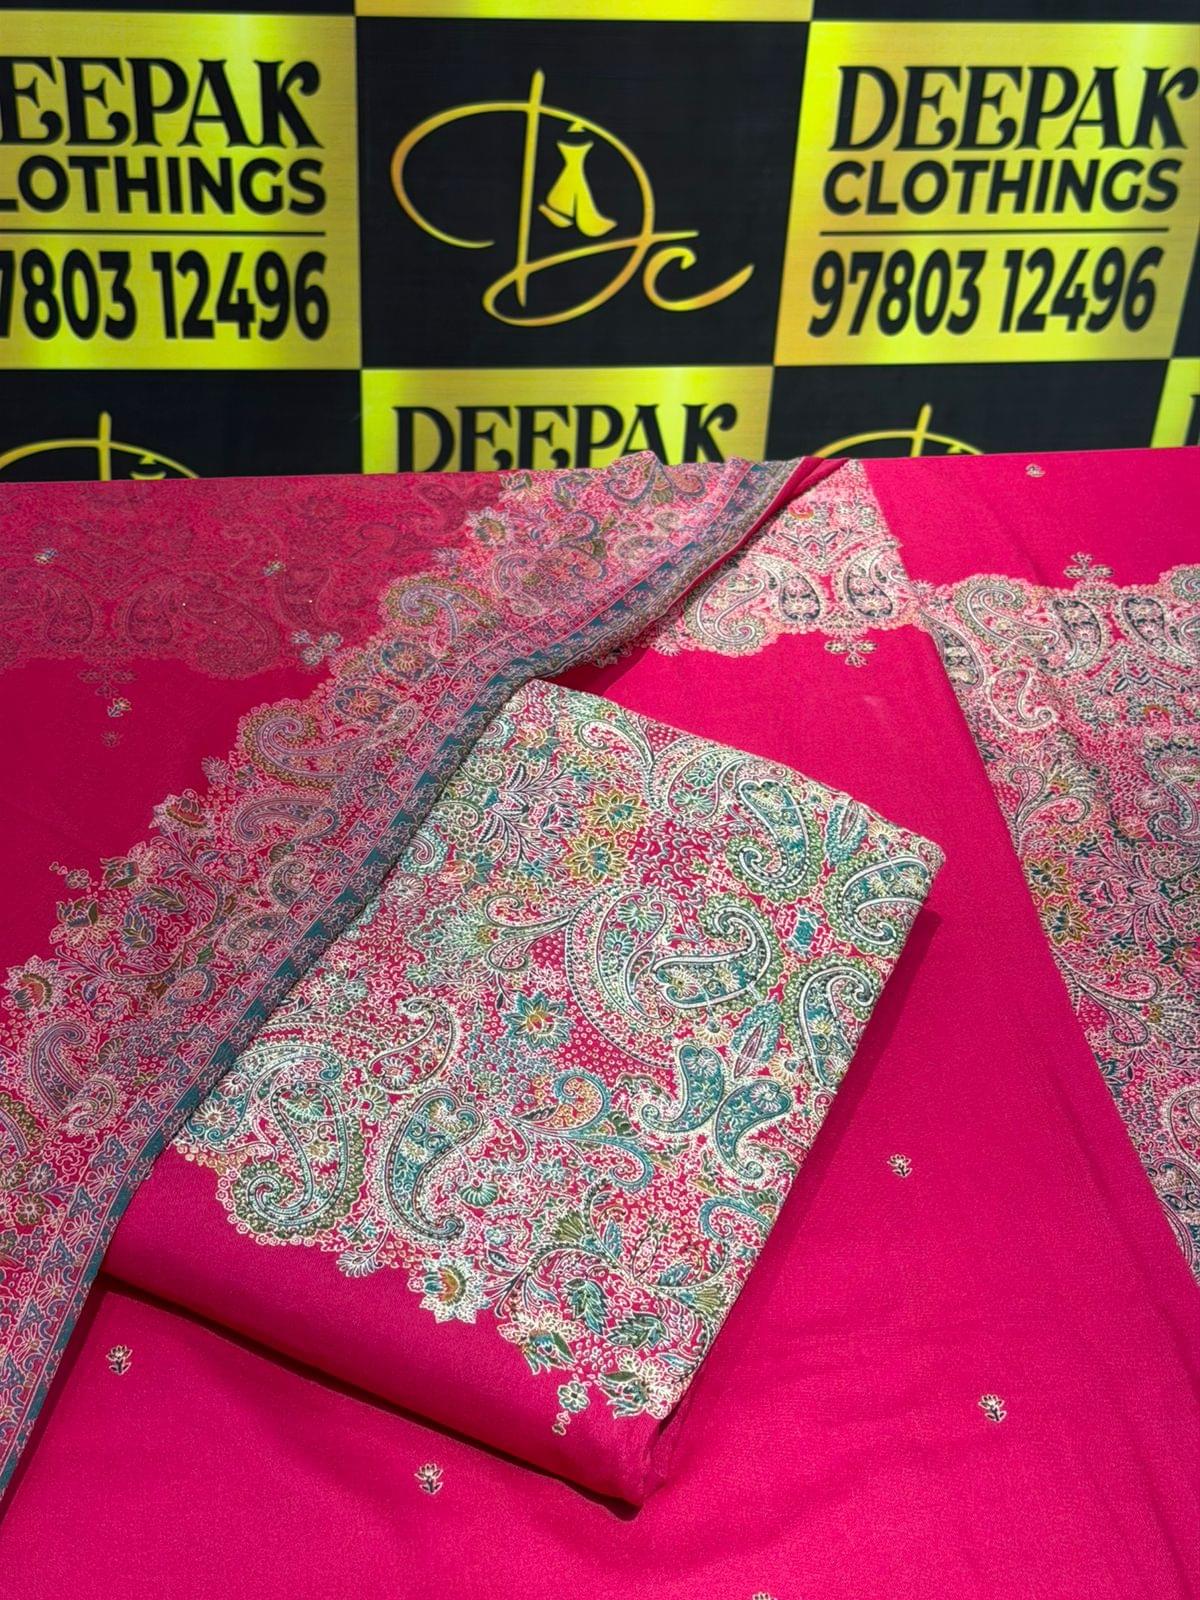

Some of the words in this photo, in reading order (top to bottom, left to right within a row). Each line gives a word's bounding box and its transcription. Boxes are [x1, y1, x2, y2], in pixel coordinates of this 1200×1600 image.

[829, 66, 1199, 151] DEEPAK
[823, 158, 1183, 216] CLOTHINGS
[151, 249, 330, 341] 12496
[808, 249, 987, 337] 97803
[1000, 246, 1164, 333] 12496
[393, 403, 738, 472] DEEPAK
